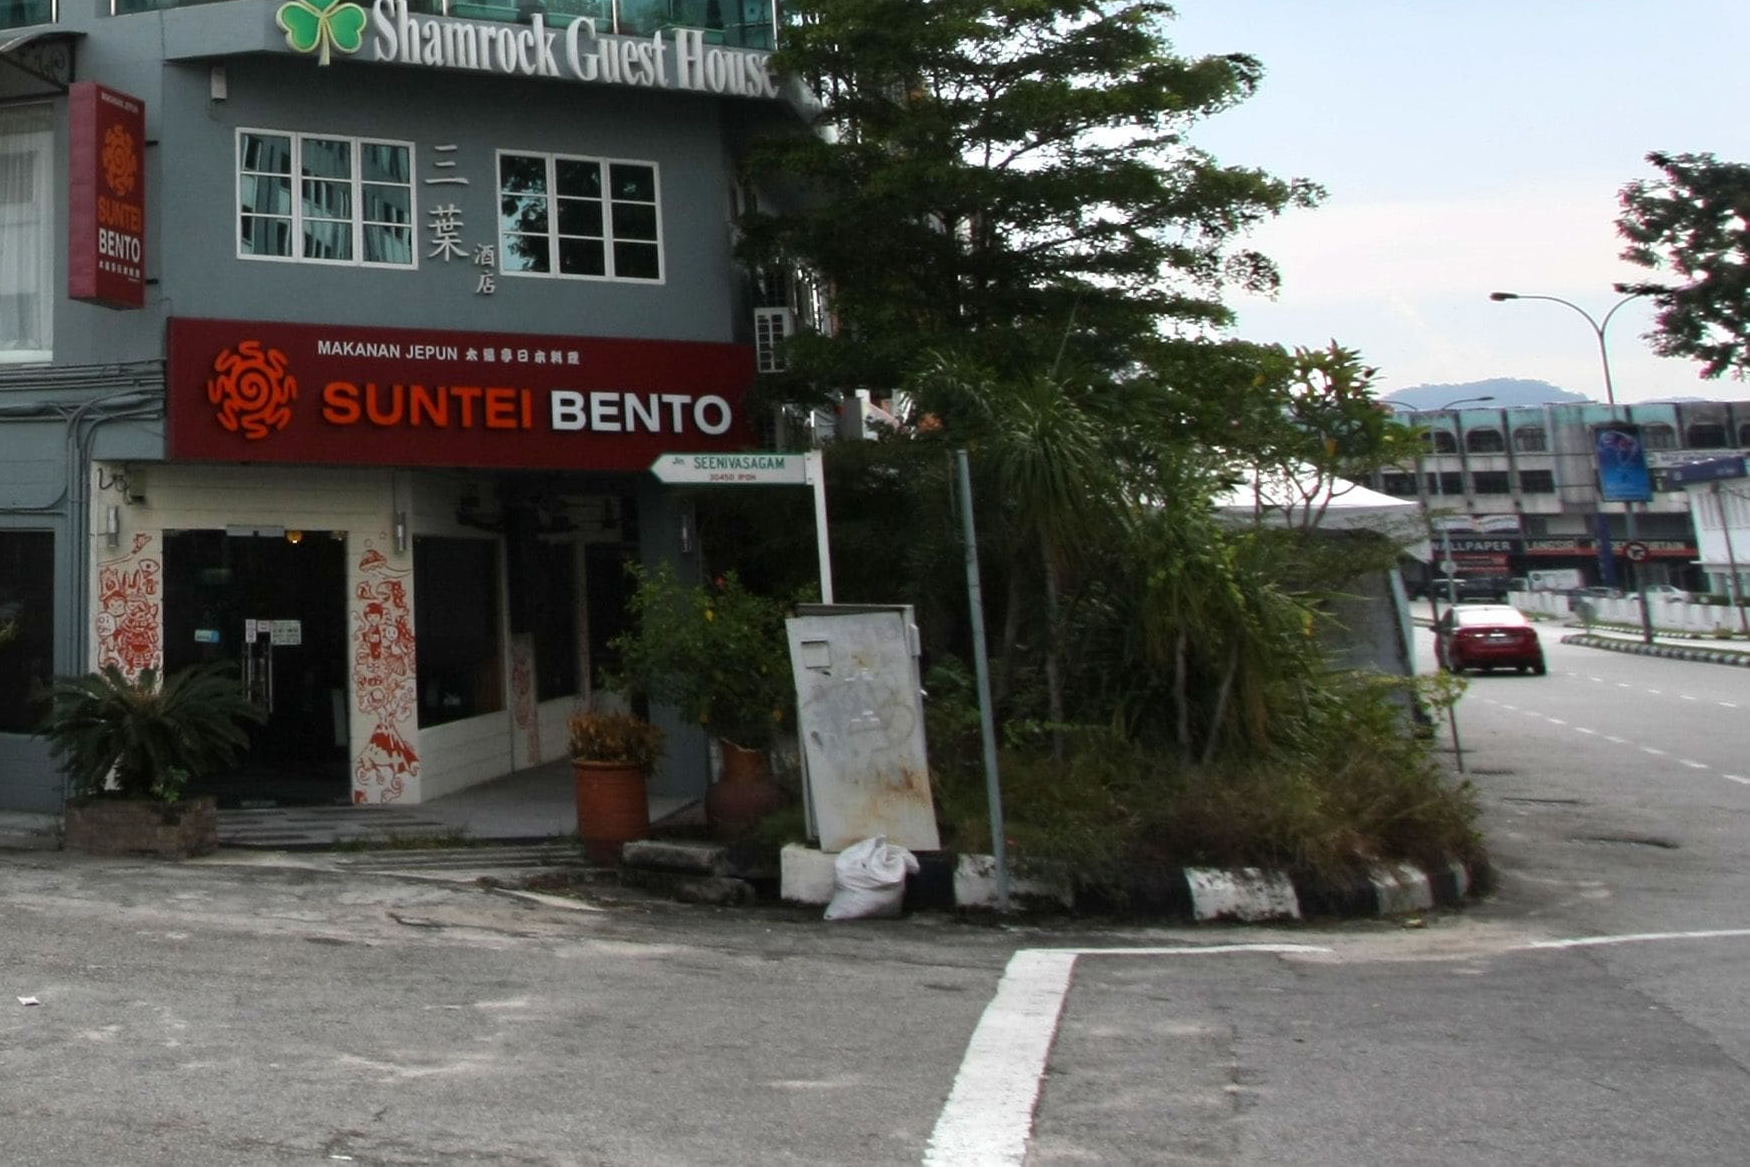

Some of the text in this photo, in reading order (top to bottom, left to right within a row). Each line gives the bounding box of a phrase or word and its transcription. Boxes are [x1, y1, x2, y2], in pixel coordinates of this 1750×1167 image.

[567, 16, 668, 86] Guest
[675, 28, 779, 99] House
[425, 144, 470, 263] 三葉
[98, 227, 141, 264] BENTO
[474, 243, 496, 295] 酒店
[317, 339, 400, 359] MAKANAN
[405, 345, 458, 361] JEPUN
[322, 381, 733, 435] SUNTEI BENTO
[694, 456, 785, 470] SEENIVASAGAM
